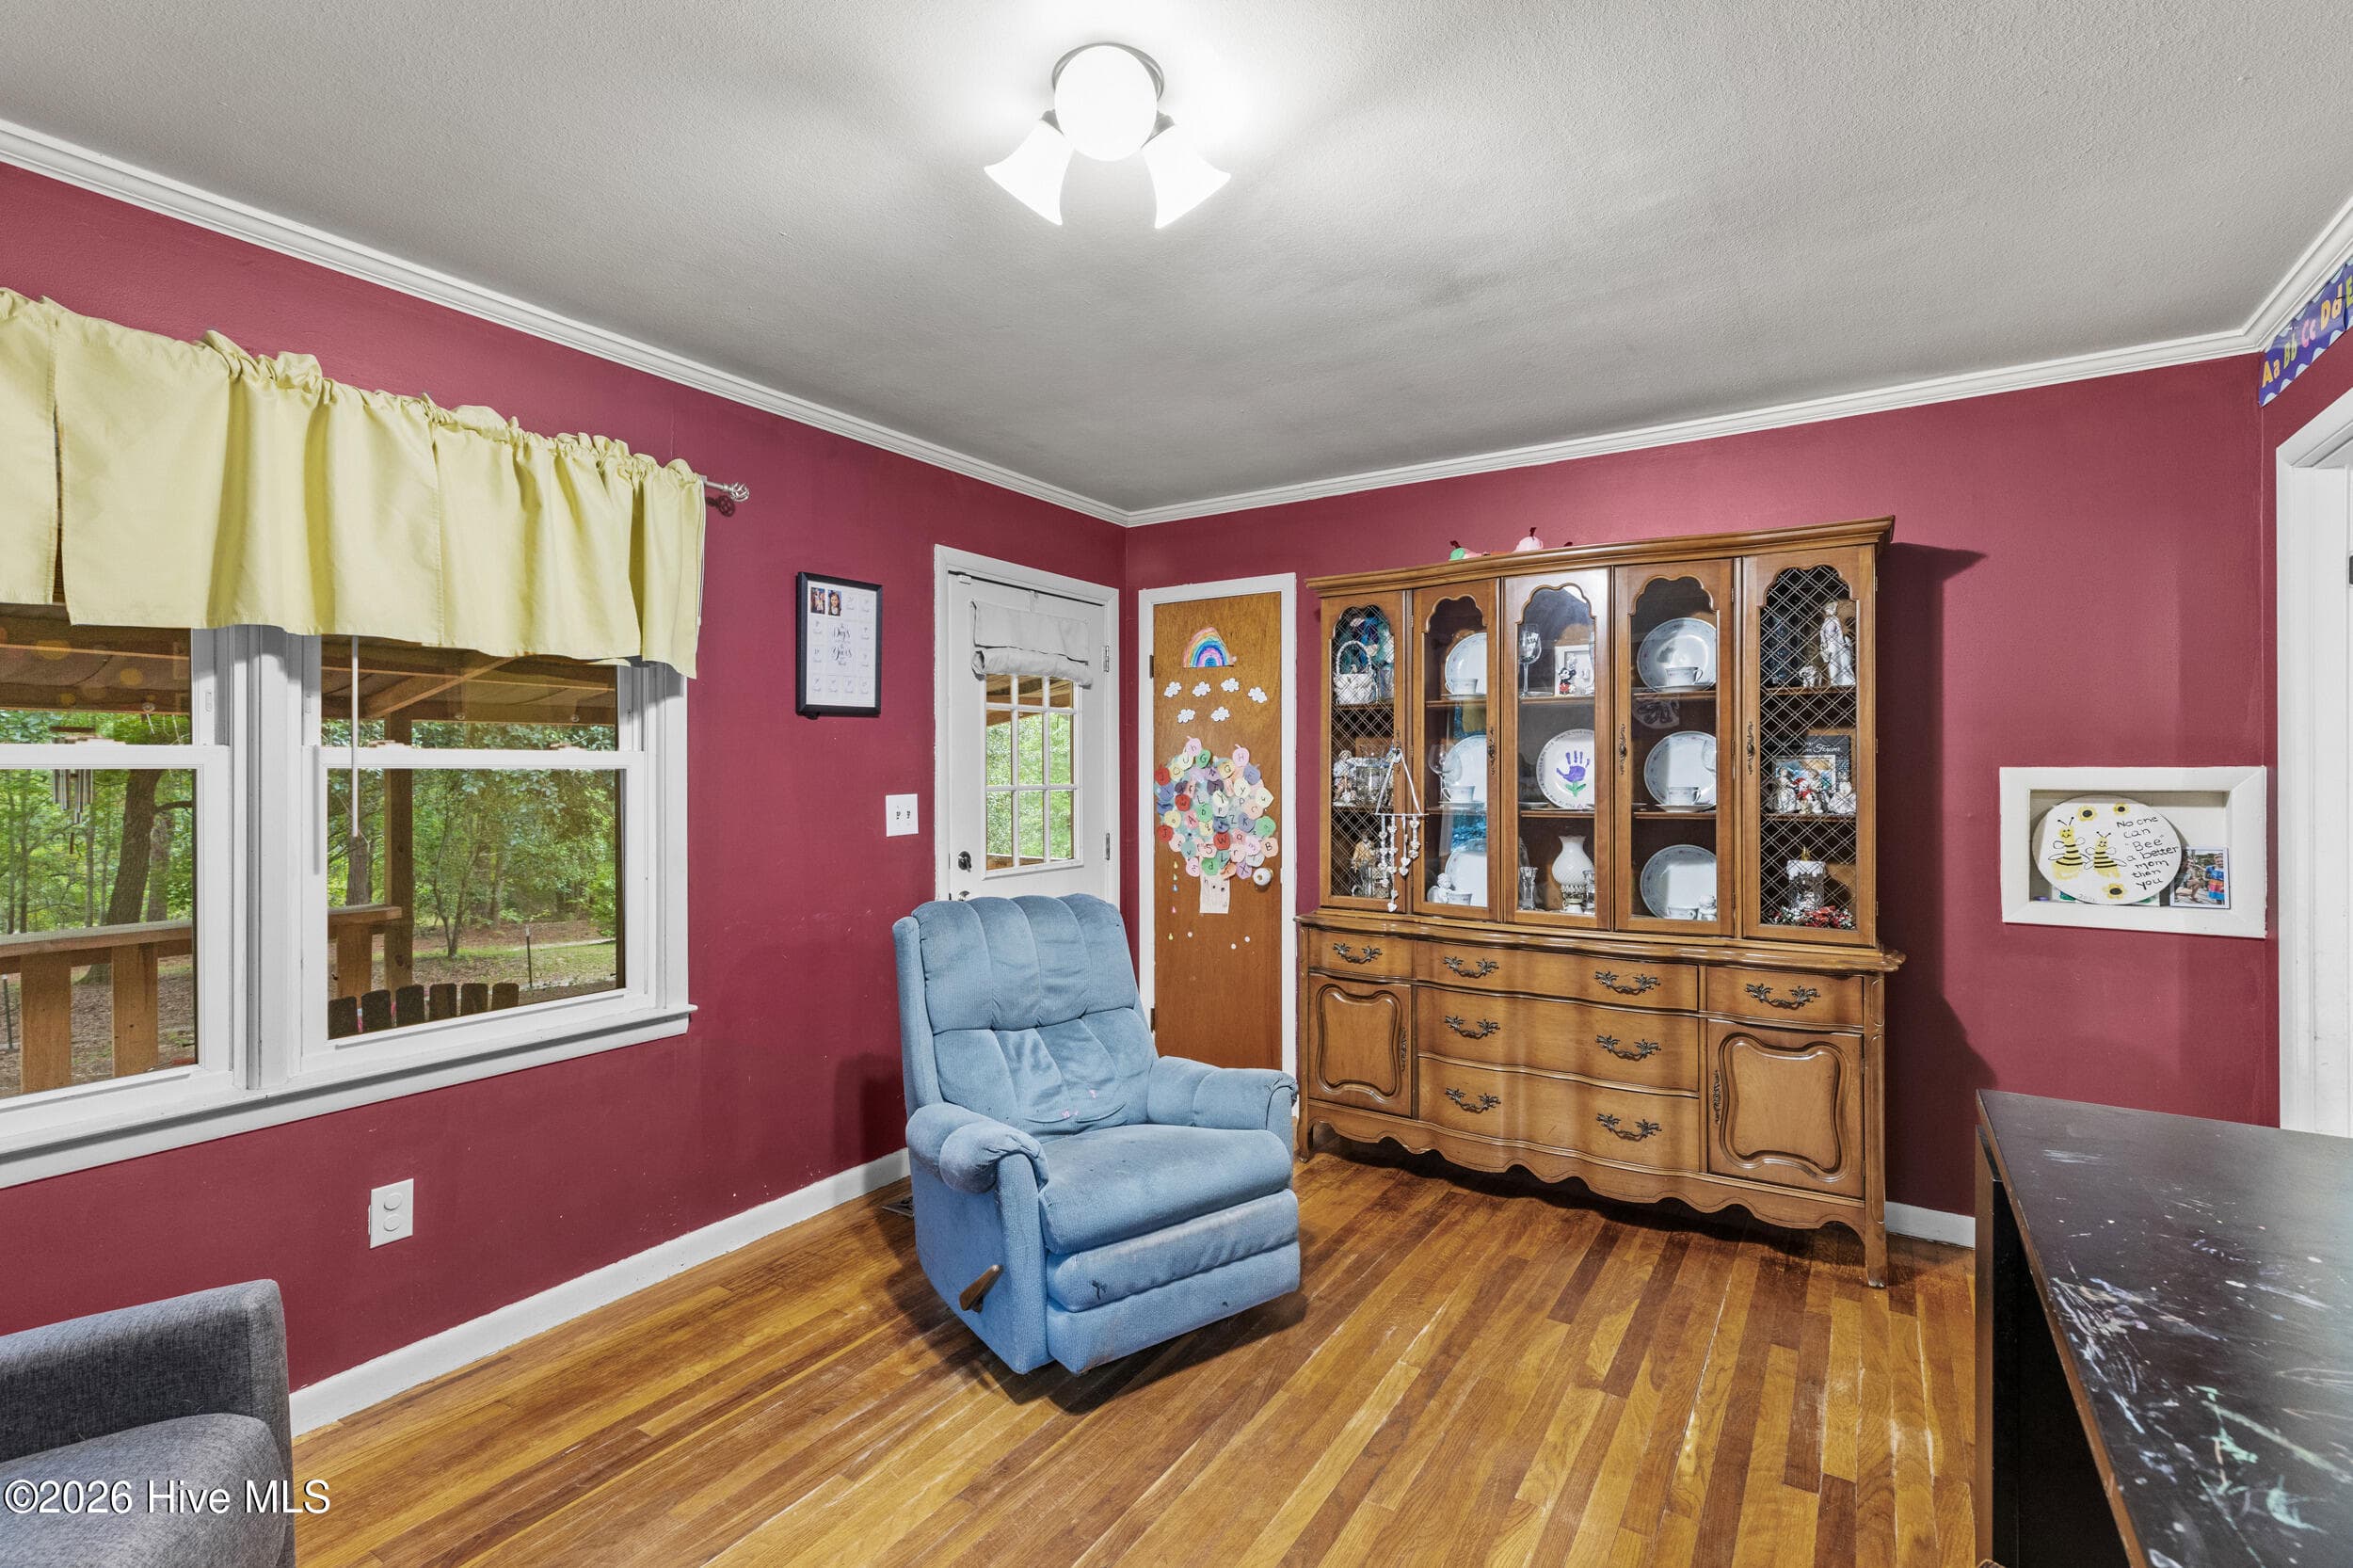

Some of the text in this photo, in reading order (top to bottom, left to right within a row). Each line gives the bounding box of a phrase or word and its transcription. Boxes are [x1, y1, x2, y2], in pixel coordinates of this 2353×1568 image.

[2262, 359, 2281, 388] Aa
[2283, 332, 2297, 369] Bb
[2301, 319, 2316, 348] Cc
[2320, 283, 2343, 331] Dd
[1199, 753, 1207, 763] G
[2116, 816, 2158, 828] No one
[2123, 828, 2151, 839] can
[2139, 846, 2179, 859] better
[2135, 860, 2169, 870] mom
[2131, 869, 2162, 878] than
[2136, 878, 2164, 890] you
